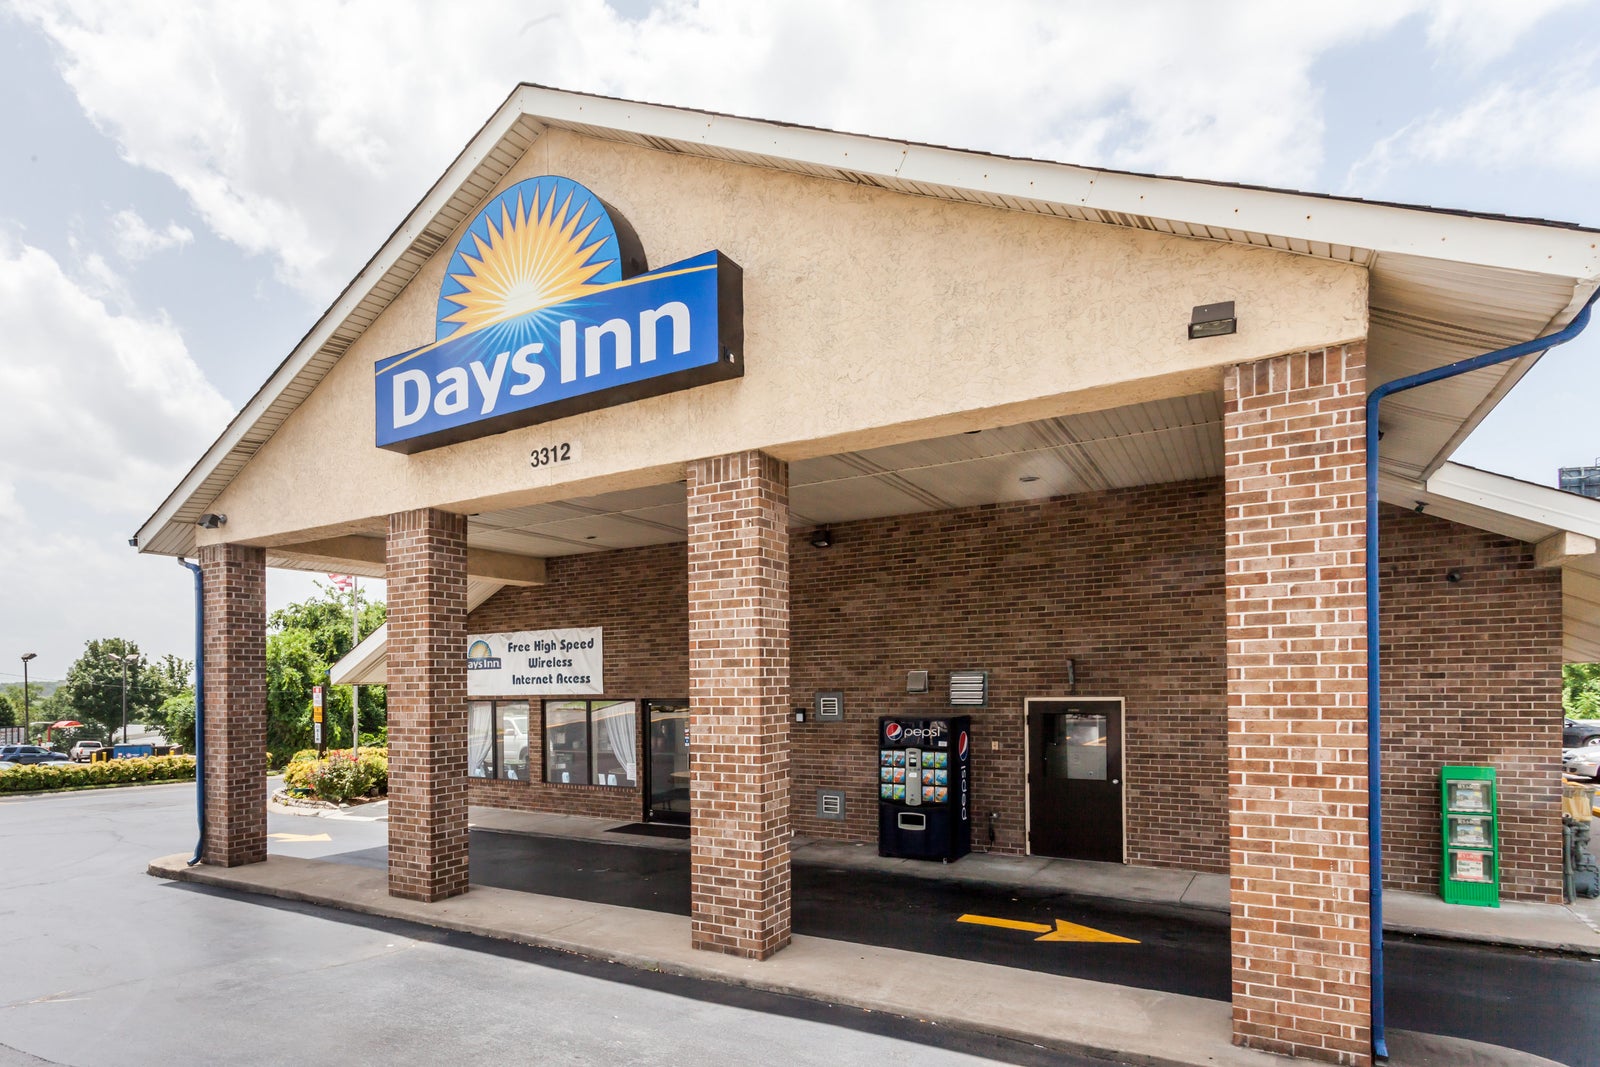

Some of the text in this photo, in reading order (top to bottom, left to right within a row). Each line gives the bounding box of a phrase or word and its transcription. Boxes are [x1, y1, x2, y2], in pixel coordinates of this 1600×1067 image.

[392, 301, 691, 429] Days Inn
[530, 443, 571, 468] 3312
[507, 638, 595, 654] Free High Speed
[467, 660, 500, 670] ays Inn
[528, 657, 573, 668] Wireless
[512, 673, 591, 685] Internet Access
[904, 726, 940, 739] pepsi
